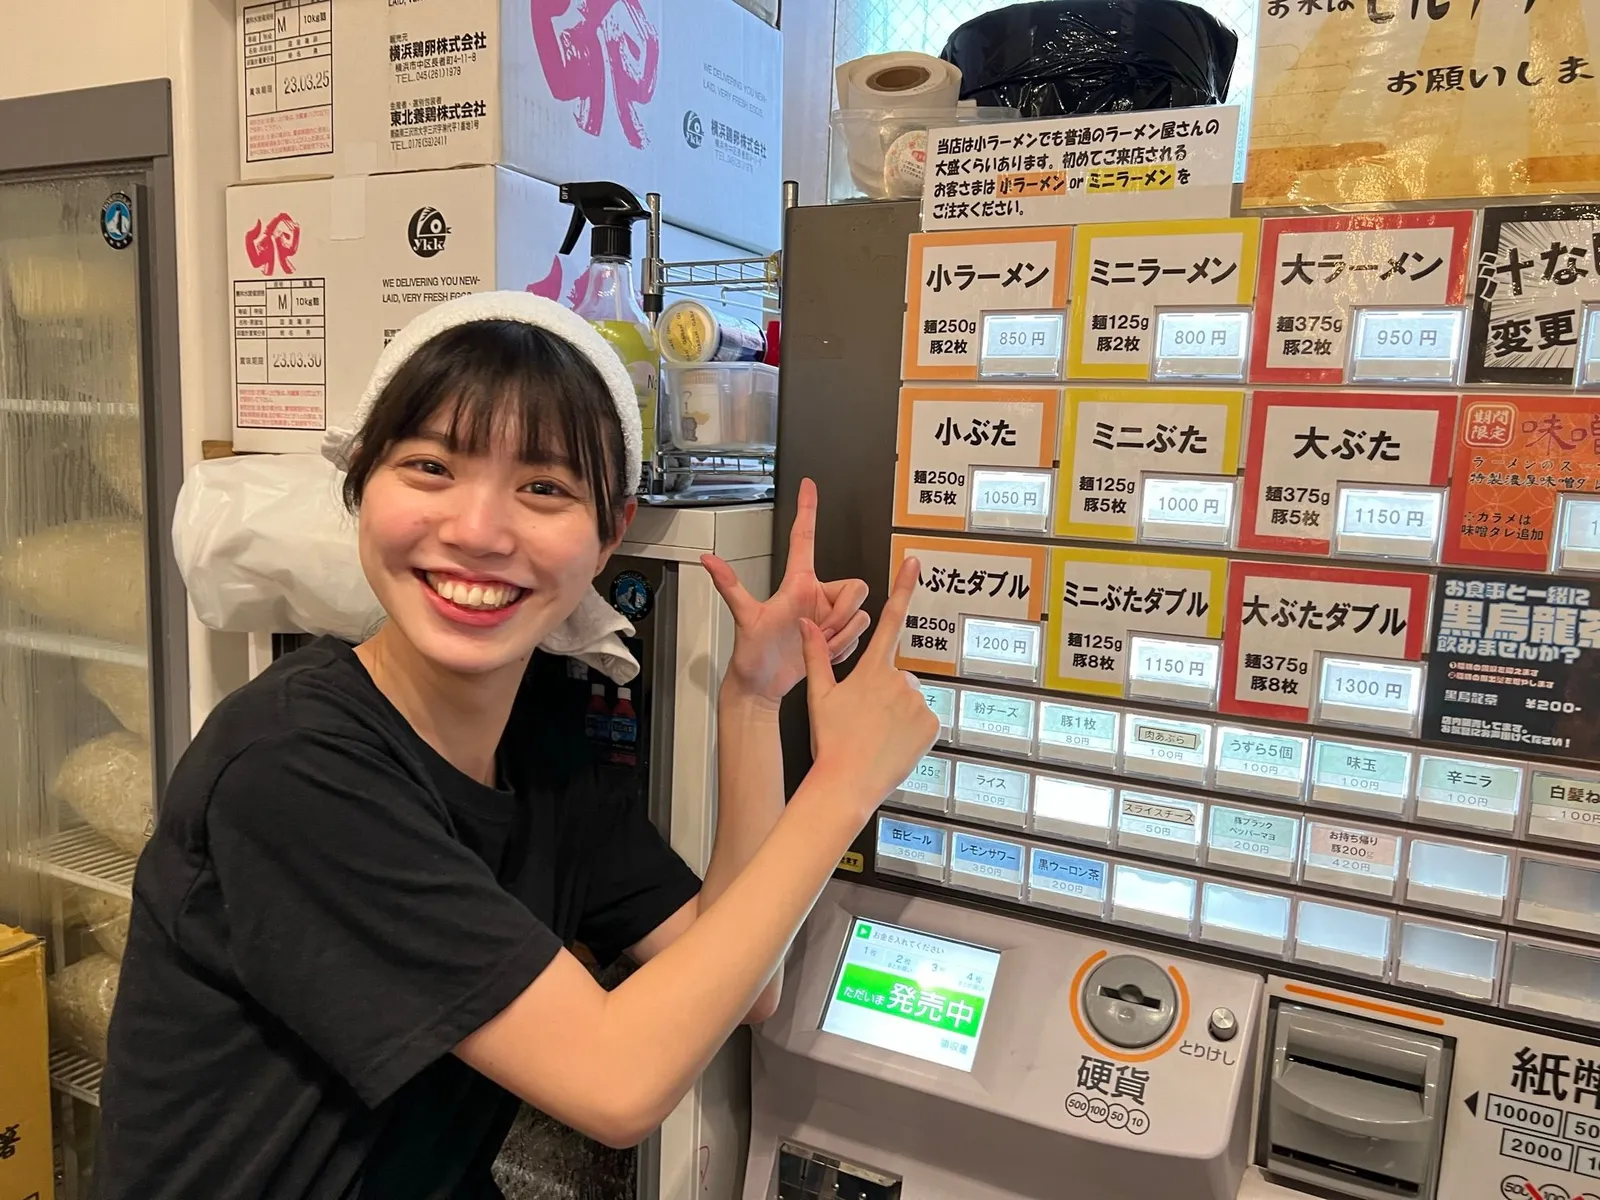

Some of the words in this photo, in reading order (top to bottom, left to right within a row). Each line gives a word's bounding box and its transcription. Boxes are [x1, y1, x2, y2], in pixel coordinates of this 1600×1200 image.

[277, 16, 287, 33] M
[389, 31, 487, 62] 横浜鶏卵株式会社
[284, 70, 330, 94] 23.03.25
[1387, 56, 1594, 95] お願いしま
[390, 100, 487, 127] 東北養鶏株式会社
[937, 118, 1220, 156] 当店は小ラーメンでも普通のラーメン屋さんの
[935, 145, 1187, 177] 大盛くらいあります。初めてご来店される
[1069, 176, 1084, 190] or
[932, 200, 1025, 219] ご注文ください。
[245, 212, 301, 276] 卵
[413, 238, 445, 251] ykk
[1090, 257, 1237, 287] ミニラーメン
[1281, 251, 1444, 287] 大ラーメン
[1478, 232, 1600, 302] 汁な
[382, 278, 394, 288] WE
[396, 277, 438, 287] DELIVERING
[440, 276, 458, 286] YOU
[459, 276, 480, 286] NEW-
[926, 262, 1050, 293] 小ラーメン
[278, 293, 287, 310] M
[382, 293, 401, 304] LAID,
[401, 293, 422, 303] VERY
[423, 292, 449, 302] FRESH
[923, 319, 977, 335] 麺250g
[1091, 314, 1150, 331] 麺125g
[1276, 316, 1343, 334] 麺375g
[1490, 308, 1577, 358] 変更
[929, 338, 968, 354] 豚2枚
[1096, 335, 1140, 353] 豚2枚
[1282, 338, 1332, 356] 豚2枚
[273, 351, 322, 368] 23.03.30
[1472, 409, 1509, 425] 期間
[934, 416, 1017, 447] 小ぶた
[1092, 421, 1207, 455] ミニぶた
[1470, 424, 1507, 441] 限定
[1293, 425, 1401, 462] 大ぶた
[913, 470, 965, 487] 麺250g
[1079, 476, 1135, 495] 麺125g
[919, 490, 957, 506] 豚5枚
[1265, 485, 1330, 505] 麺375g
[1083, 496, 1127, 514] 豚5枚
[1270, 508, 1320, 527] 豚5枚
[1461, 524, 1544, 541] 味噌タレ追加
[916, 566, 1030, 600] ぶたダブル
[1063, 580, 1209, 618] ミニぶたダブル
[1444, 579, 1591, 606] お食事と一緒に
[905, 614, 956, 634] 麺250g
[1241, 594, 1407, 637] 大ぶたダブル
[910, 635, 948, 651] 豚8枚
[1067, 631, 1123, 652] 麺125g
[1436, 635, 1581, 664] 飲みませんか？
[1072, 653, 1115, 671] 豚8枚
[1244, 653, 1308, 675] 麺375g
[1251, 675, 1299, 695] 豚8枚
[1444, 689, 1498, 706] 黒烏龍茶
[974, 702, 1018, 719] 粉チーズ
[980, 722, 1011, 734] 100円
[1060, 715, 1097, 731] 豚1枚
[1065, 735, 1090, 746] 80円
[1144, 730, 1185, 745] 肉あぶら
[1150, 748, 1183, 760] 100円
[1230, 738, 1293, 760] うずら5個
[1243, 762, 1279, 776] 100円
[1346, 755, 1377, 773] 味玉
[903, 780, 929, 791] 00円
[976, 774, 1007, 790] ライス
[1342, 777, 1380, 791] 100円
[1446, 770, 1492, 788] 辛ニラ
[976, 793, 1005, 806] 100円
[1448, 793, 1488, 808] 100円
[1550, 785, 1600, 804] 白髪ね
[1125, 801, 1194, 824] スライスチーズ
[891, 828, 932, 845] 缶ビール
[1145, 824, 1171, 837] 50円
[1328, 831, 1378, 846] お持ち帰り
[897, 847, 925, 861] 350円
[960, 842, 1016, 862] レモンサワー
[1233, 840, 1270, 854] 200円
[972, 863, 1002, 877] 350円
[1038, 858, 1100, 881] 黒ウーロン茶
[1332, 858, 1371, 872] 420円
[1051, 880, 1083, 894] 200円
[872, 930, 945, 954] お金を入れてください
[1179, 1040, 1236, 1066] とりけし
[1077, 1054, 1150, 1106] 硬貨
[1068, 1099, 1087, 1111] 500
[1090, 1105, 1106, 1117] 100
[1111, 1111, 1124, 1122] 50
[1132, 1117, 1143, 1128] 10
[1493, 1102, 1555, 1128] 10000
[1511, 1138, 1562, 1162] 2000
